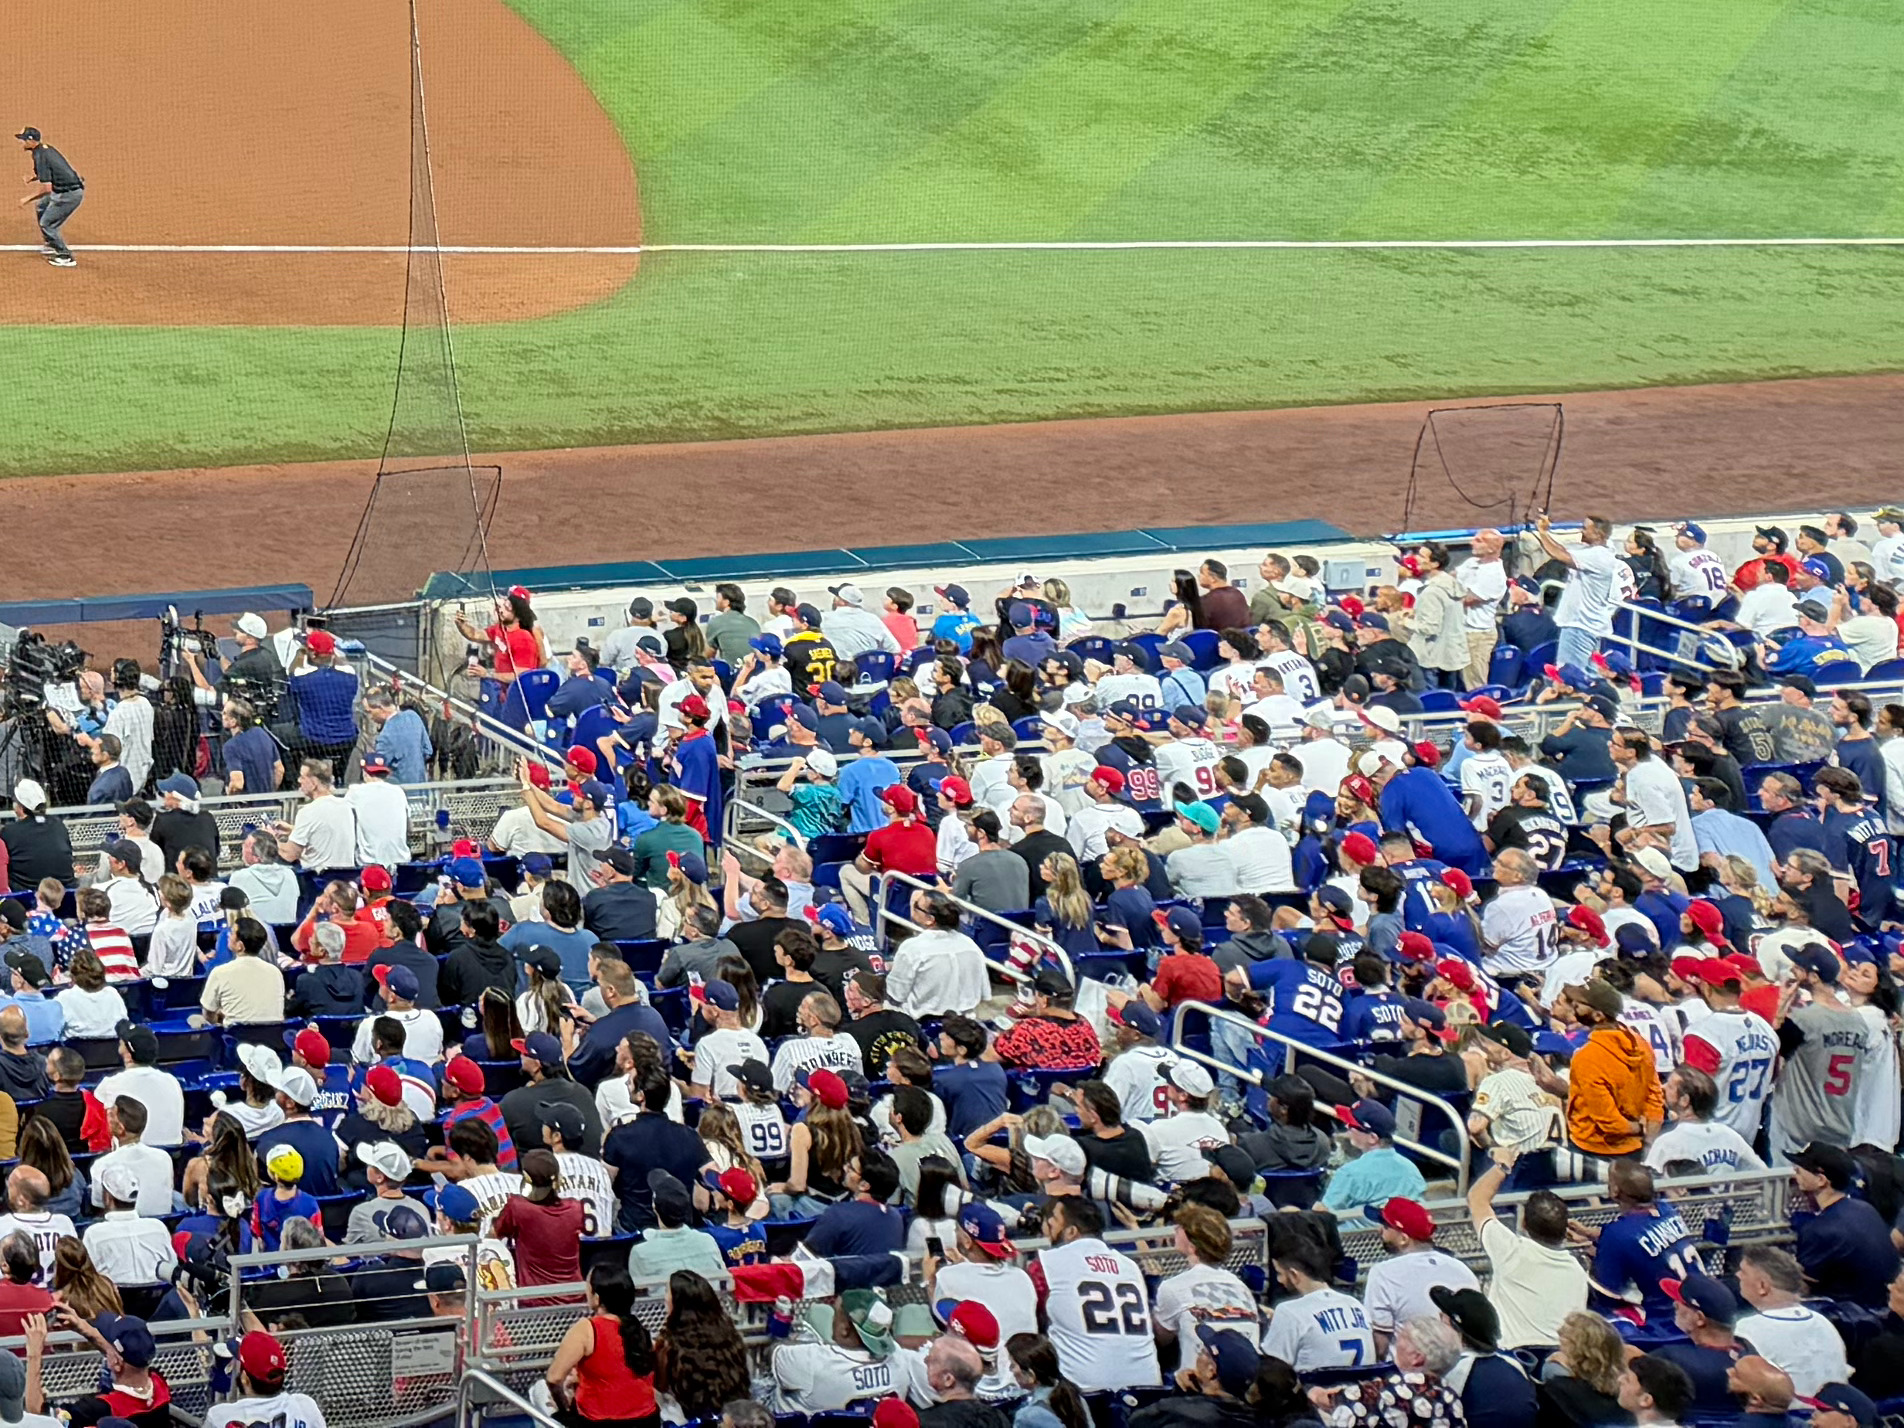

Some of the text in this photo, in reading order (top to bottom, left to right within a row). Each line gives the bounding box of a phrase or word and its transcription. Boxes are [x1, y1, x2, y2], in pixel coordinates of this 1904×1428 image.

[1867, 838, 1891, 876] 7
[1306, 968, 1344, 998] SOTO
[1293, 984, 1344, 1033] 22
[1728, 1058, 1771, 1104] 27
[1823, 1054, 1854, 1097] 5
[751, 1122, 783, 1153] 99
[1085, 1256, 1120, 1275] SOTO
[1076, 1280, 1149, 1338] 22
[852, 1366, 891, 1391] SOTO
